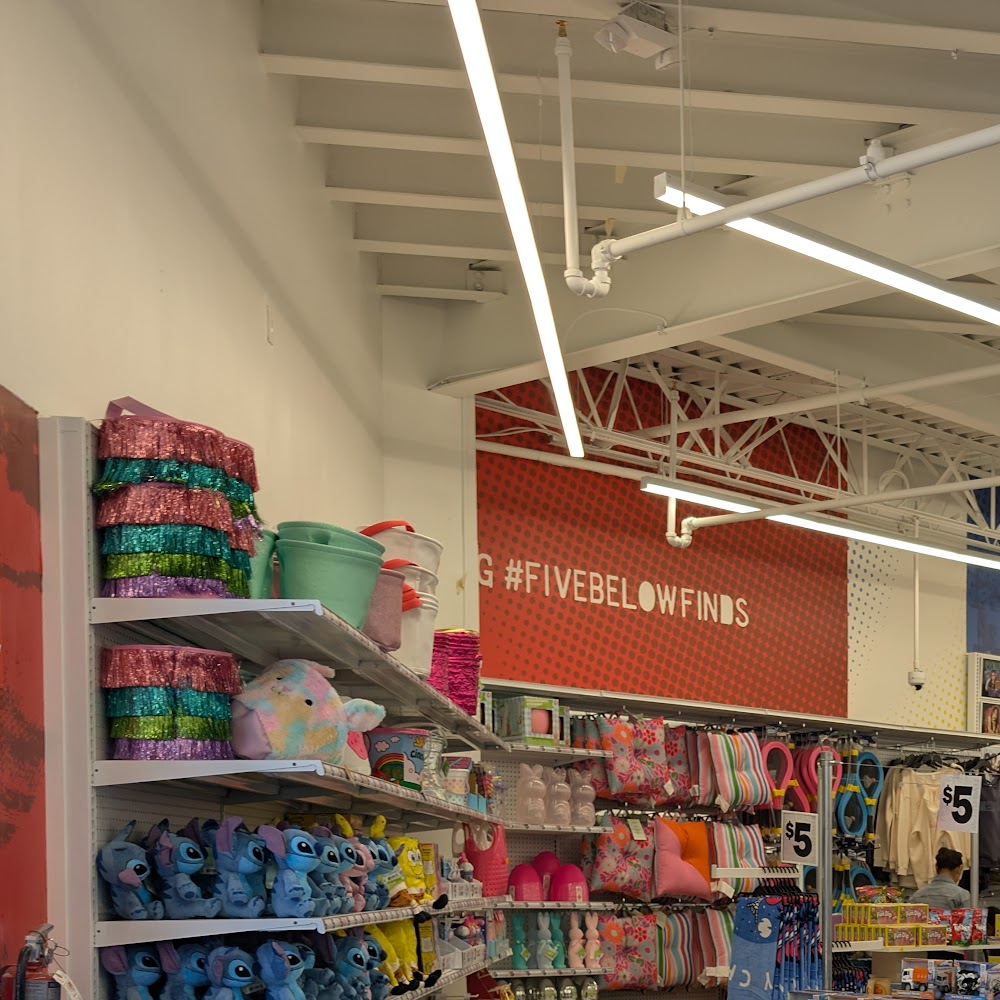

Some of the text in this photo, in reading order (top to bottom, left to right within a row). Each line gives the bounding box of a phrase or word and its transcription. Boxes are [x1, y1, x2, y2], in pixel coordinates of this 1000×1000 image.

[504, 558, 750, 628] #FIVEBELOWFINDS
[943, 785, 973, 824] $5
[785, 820, 812, 857] $5
